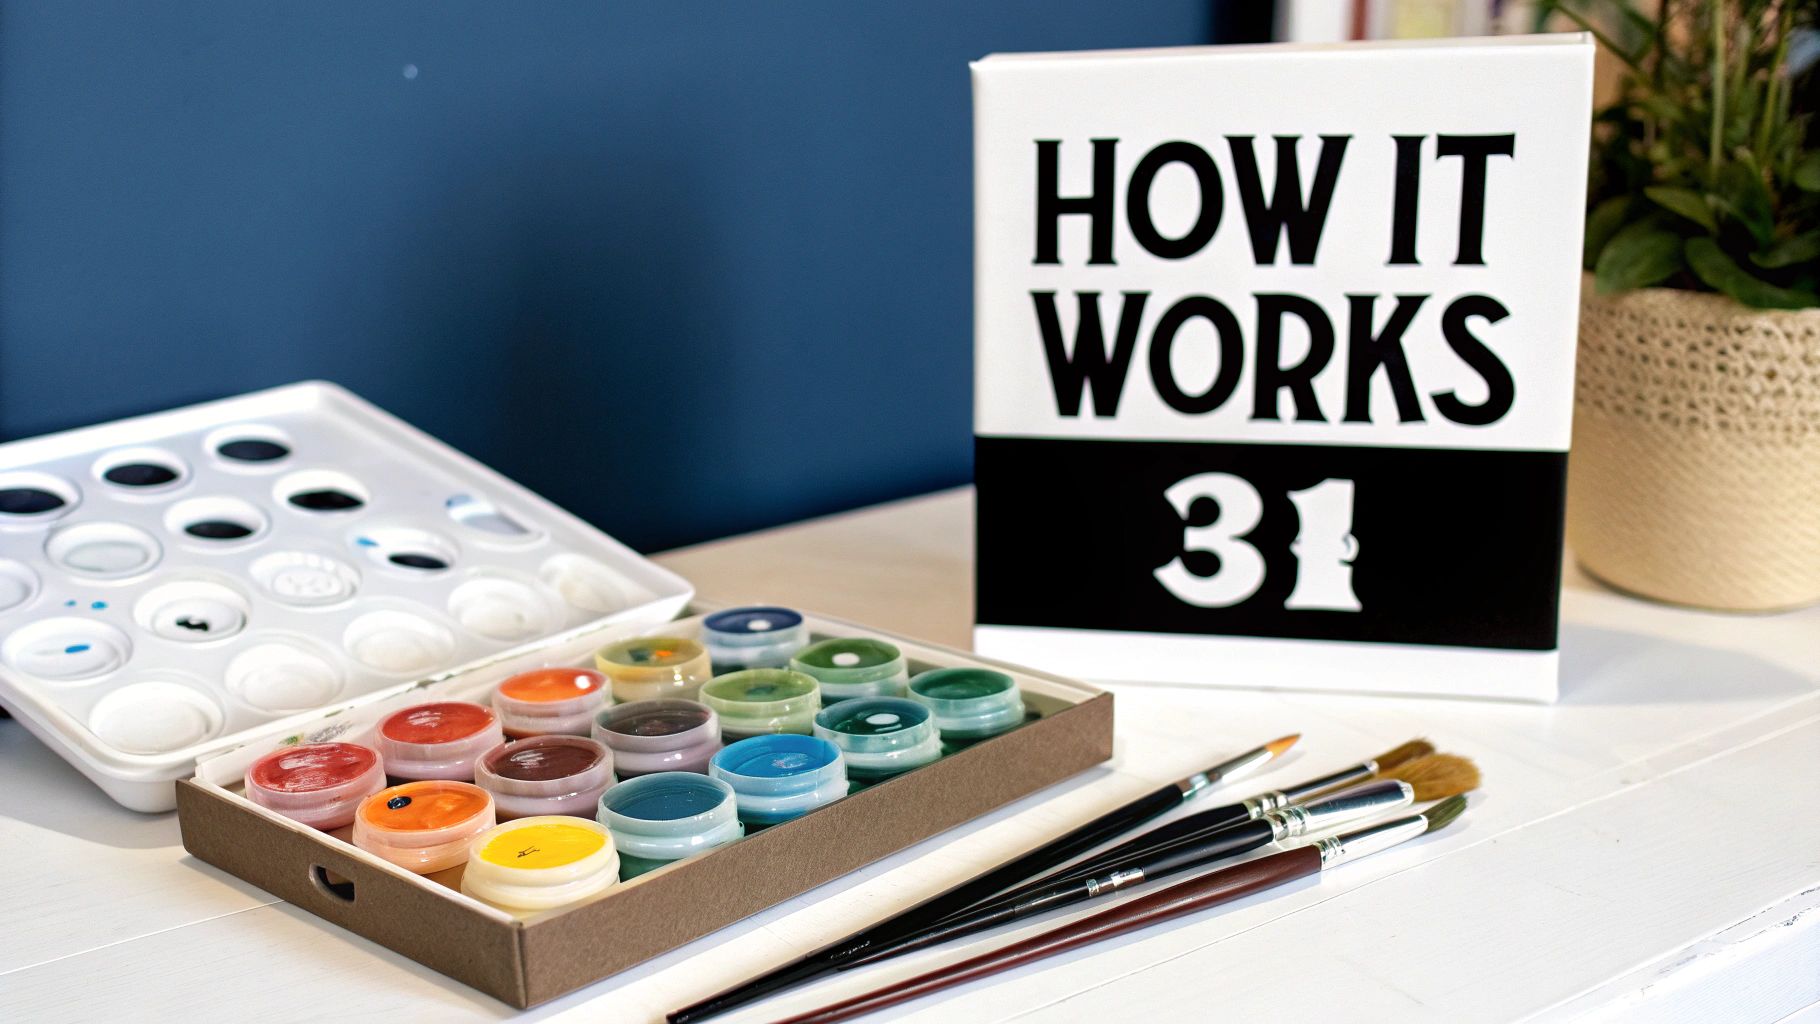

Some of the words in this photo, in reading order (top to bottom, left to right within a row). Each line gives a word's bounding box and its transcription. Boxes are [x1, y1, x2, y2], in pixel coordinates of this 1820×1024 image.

[1032, 134, 1353, 266] HOW
[1387, 133, 1516, 266] IT
[1029, 290, 1515, 427] WORKS
[1154, 472, 1362, 612] 31
